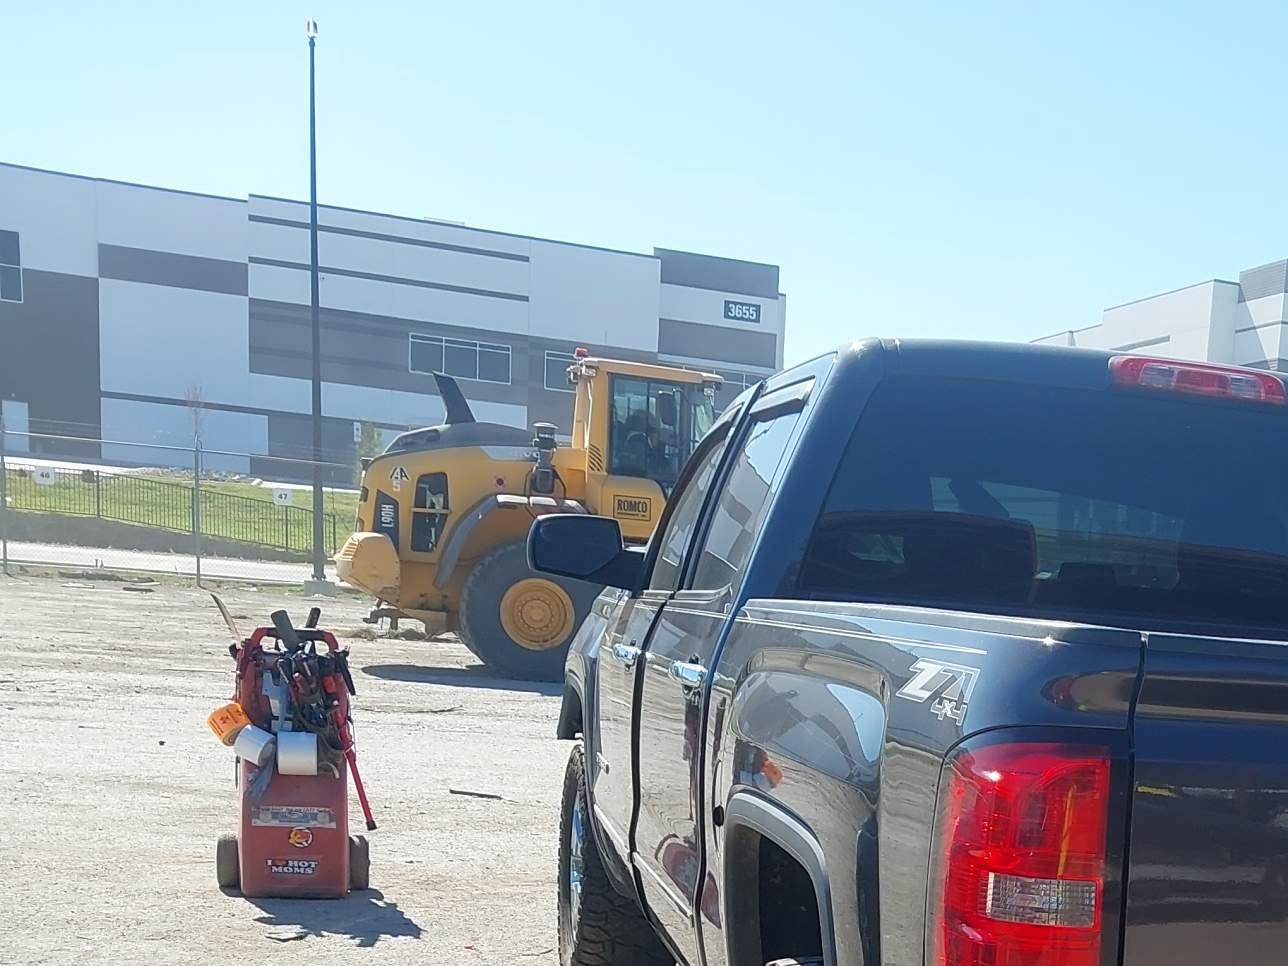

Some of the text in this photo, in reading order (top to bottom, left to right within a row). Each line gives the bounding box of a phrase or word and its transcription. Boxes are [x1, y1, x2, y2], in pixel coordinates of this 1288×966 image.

[727, 303, 757, 320] 3655
[278, 493, 288, 501] 47
[617, 498, 648, 513] ROMCO
[381, 504, 395, 528] L90H
[896, 657, 981, 703] Z71
[271, 865, 314, 874] MOMS
[287, 859, 319, 868] HOT
